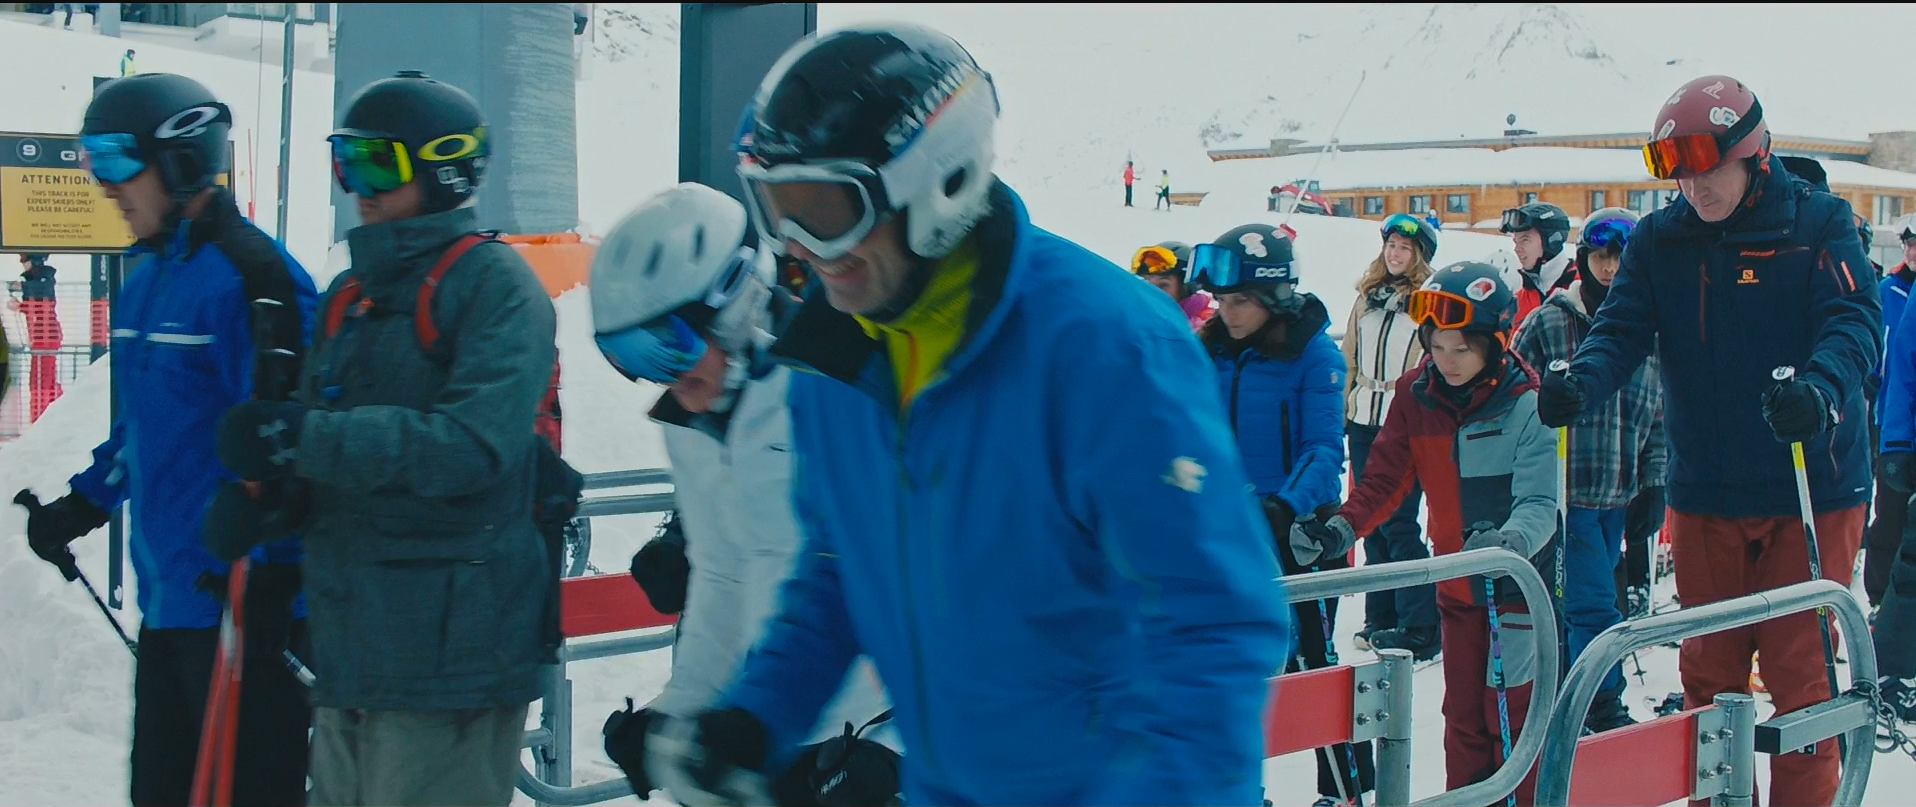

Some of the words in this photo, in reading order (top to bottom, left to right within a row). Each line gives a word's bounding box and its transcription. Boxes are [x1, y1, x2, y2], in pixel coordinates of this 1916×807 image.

[23, 144, 36, 156] 9
[21, 174, 91, 185] ATTENTION
[1255, 267, 1287, 277] POC
